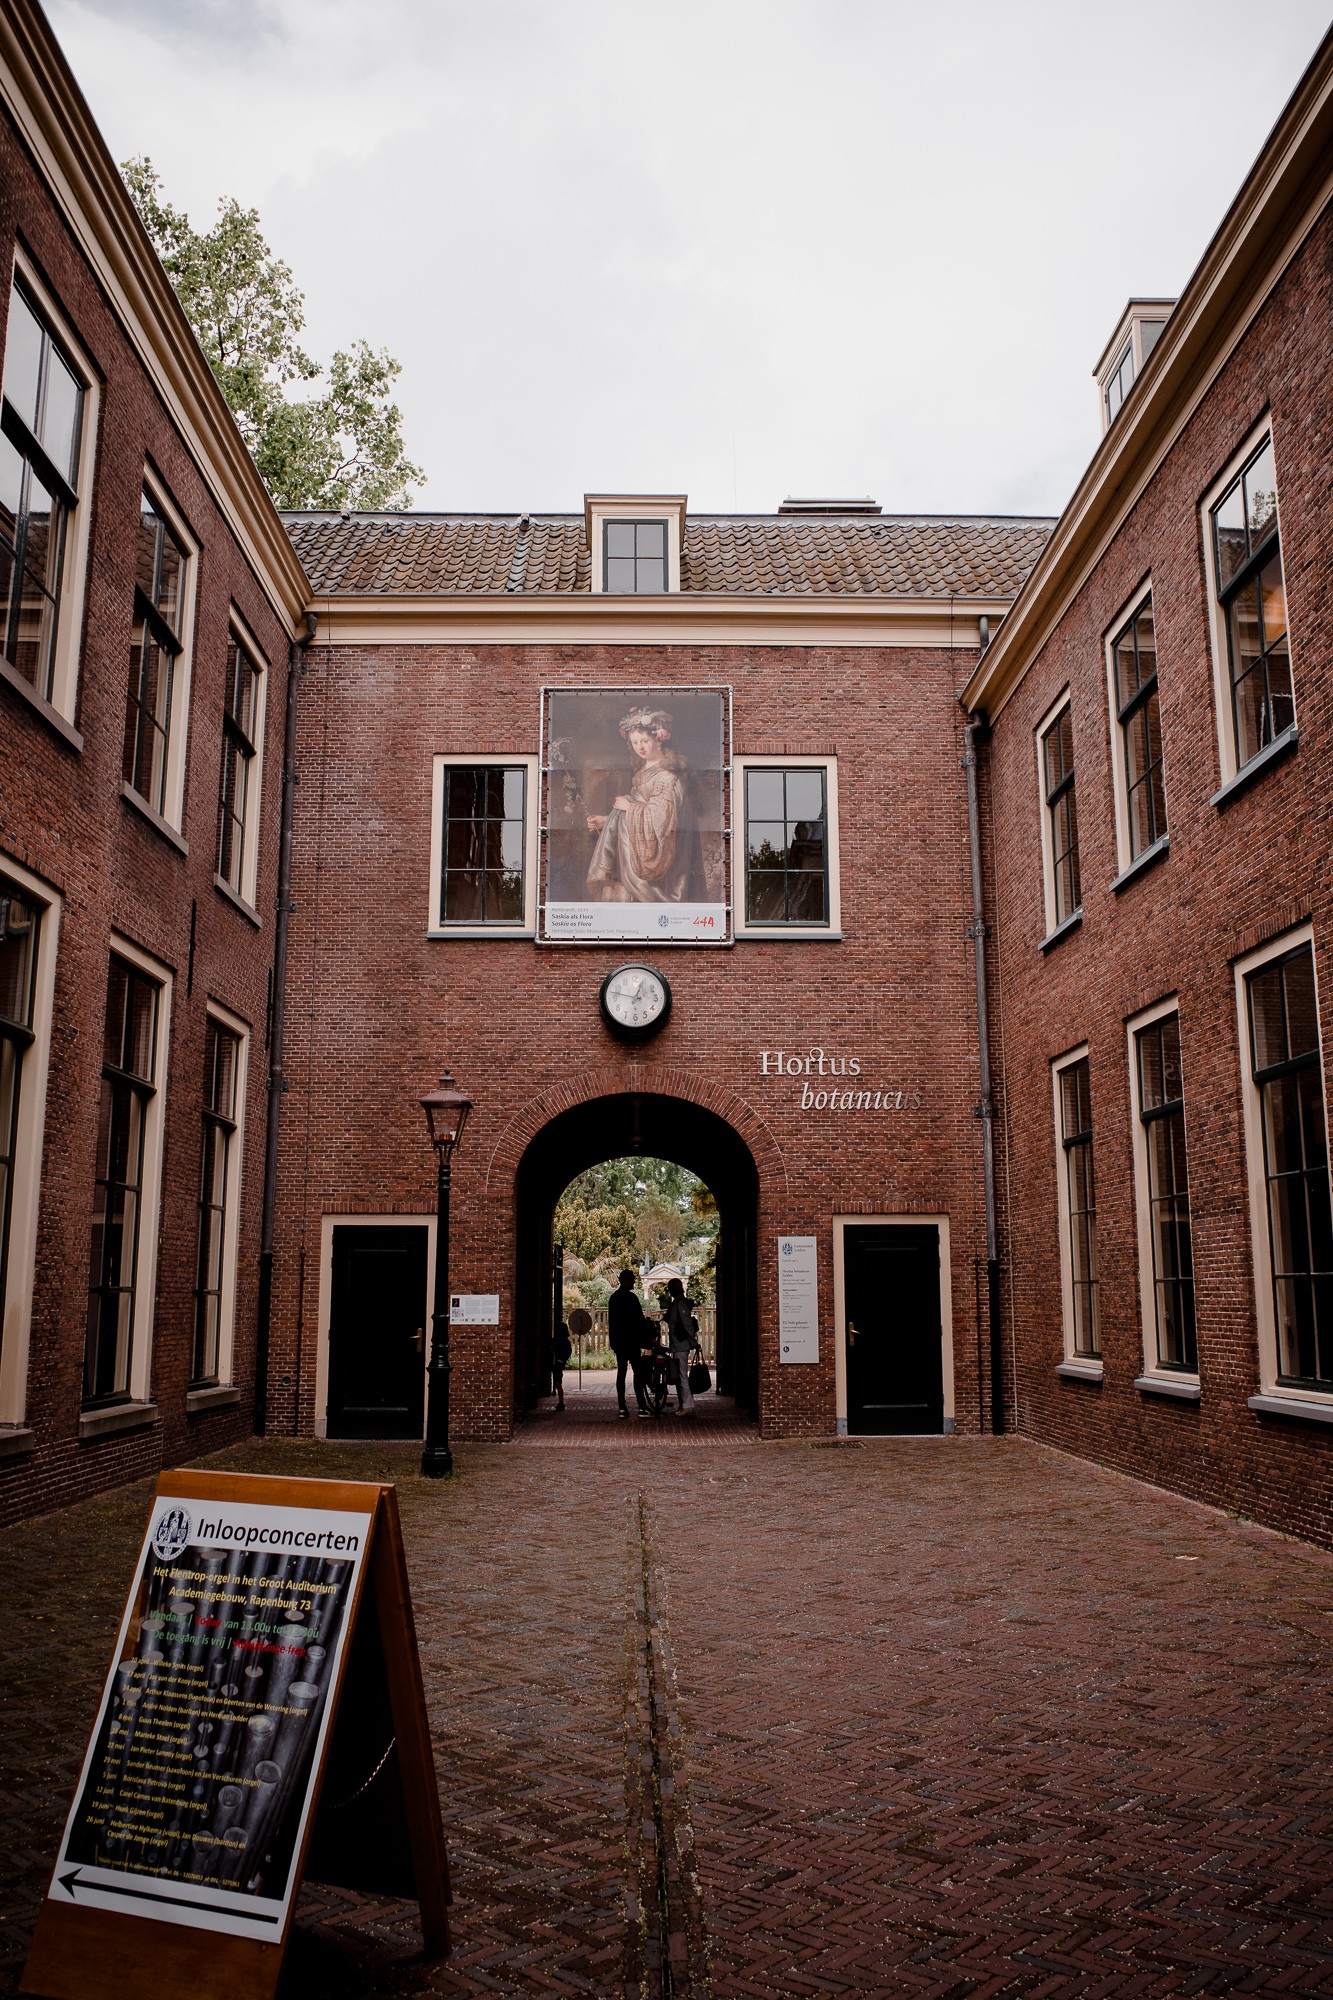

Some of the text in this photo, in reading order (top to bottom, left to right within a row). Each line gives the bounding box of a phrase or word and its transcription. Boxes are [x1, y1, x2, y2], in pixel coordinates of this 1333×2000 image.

[759, 1047, 861, 1076] Hortus
[800, 1082, 922, 1110] botanicus
[197, 1518, 359, 1551] Inloopconcerten
[153, 1566, 336, 1593] Het Flentrop-orgel in het Groot Auditorium
[169, 1586, 311, 1610] Academiegebouw, Rapenburg 73
[195, 1615, 221, 1628] Today
[241, 1620, 270, 1632] 13.00u
[153, 1630, 164, 1638] De
[166, 1631, 200, 1645] toegang
[202, 1635, 209, 1644] is
[211, 1637, 226, 1648] vrij
[178, 1707, 200, 1716] (bariton)
[264, 1704, 288, 1712] Wetering
[289, 1707, 307, 1715] (orgel)
[173, 1722, 191, 1730] (orgel)
[134, 1731, 155, 1739] Marieke
[170, 1736, 187, 1745] (orgel)
[175, 1752, 193, 1761] (orgel)
[123, 1775, 146, 1783] Borislava
[168, 1782, 186, 1791] (orgel)
[145, 1763, 165, 1771] Beumer
[166, 1766, 194, 1776] (saxofoon)
[212, 1773, 242, 1782] Verschuren
[243, 1778, 261, 1787] (orgel)
[162, 1797, 188, 1807] Batenburg
[189, 1801, 207, 1810] (orgel)
[146, 1810, 164, 1819] (orgel)
[134, 1834, 149, 1843] Jonge
[150, 1837, 169, 1847] (orgel)
[139, 1825, 162, 1834] Hylkema
[192, 1834, 214, 1842] Douwes
[214, 1837, 238, 1848] (bariton)
